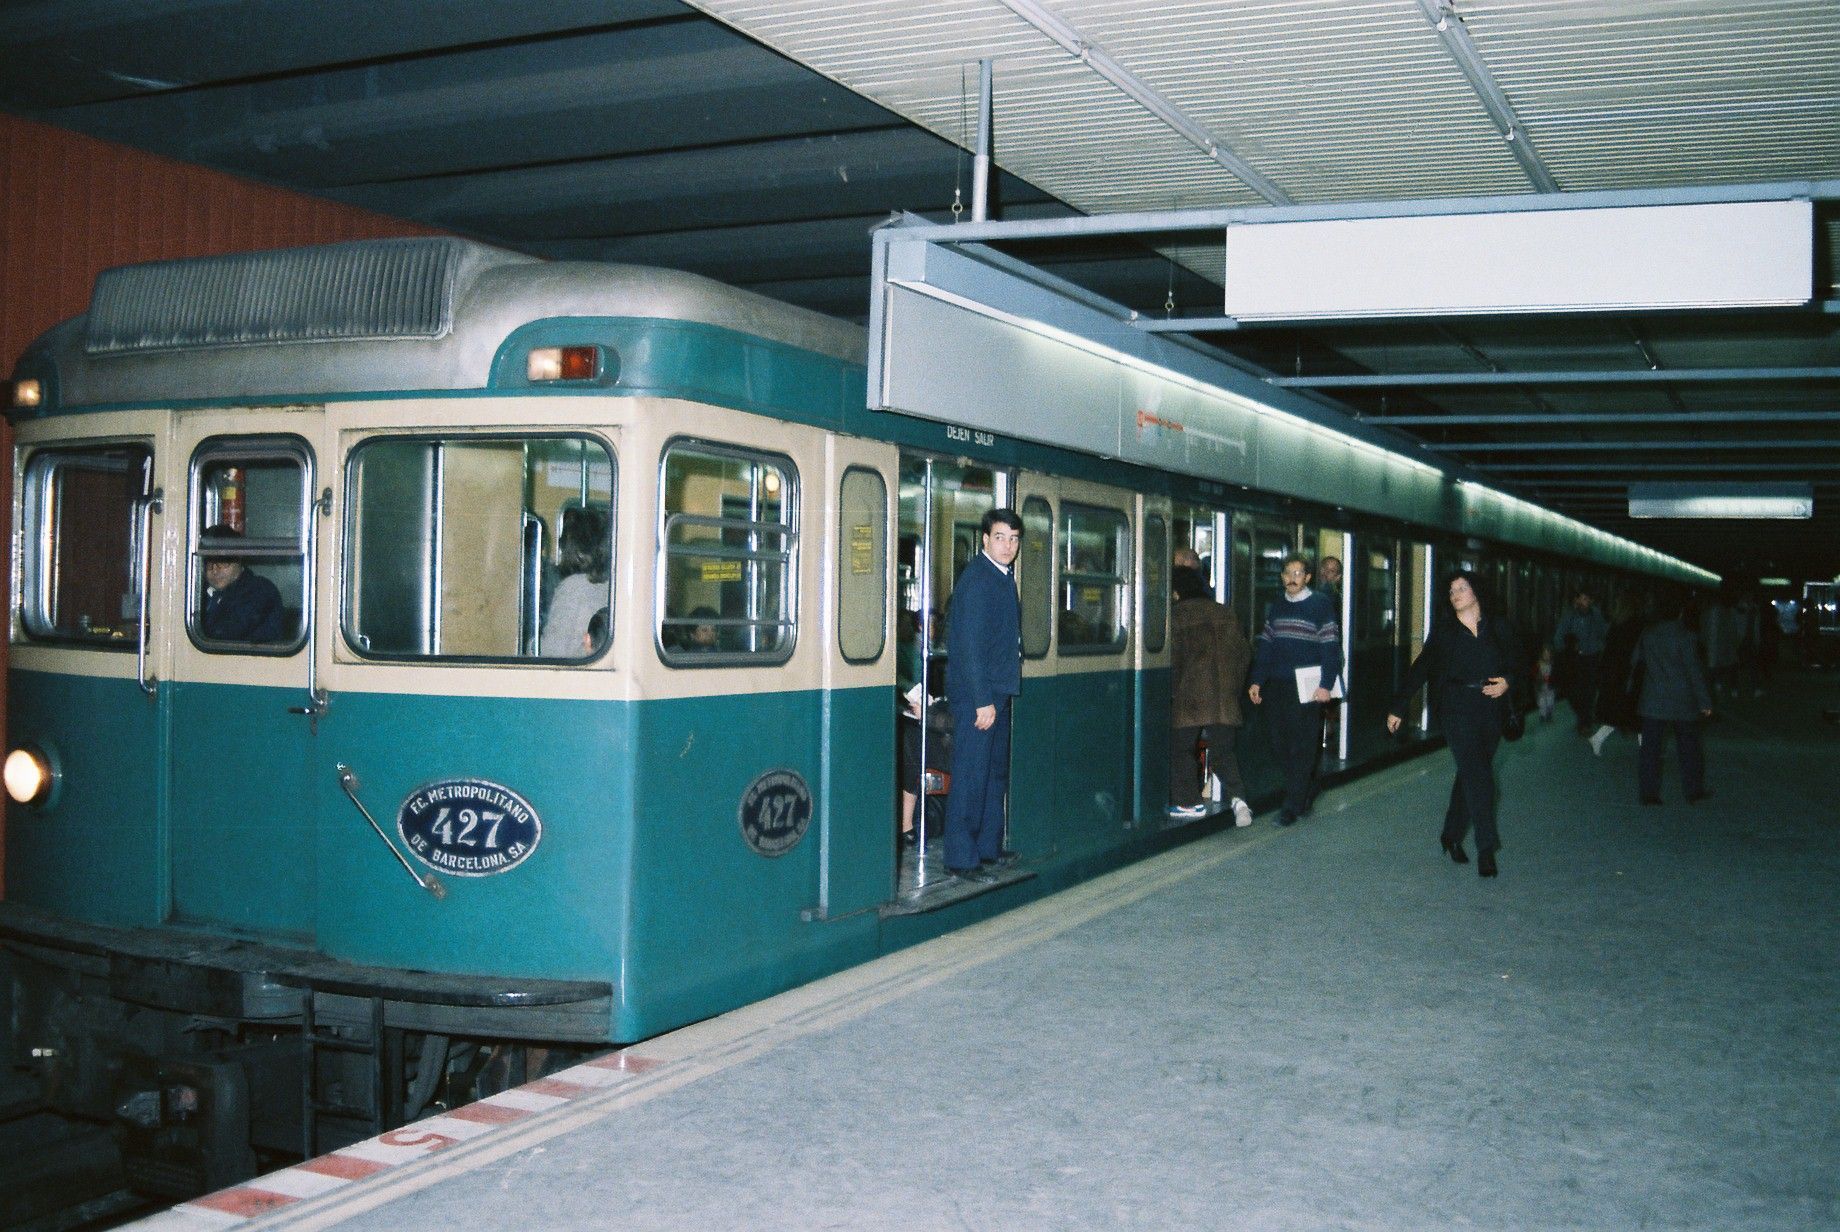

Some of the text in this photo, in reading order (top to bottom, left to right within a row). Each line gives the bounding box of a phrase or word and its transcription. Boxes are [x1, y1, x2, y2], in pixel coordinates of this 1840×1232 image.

[946, 425, 994, 446] DEJEN SALIR
[427, 785, 529, 824] METROPOLITANO
[431, 807, 505, 848] 427
[410, 833, 428, 852] DE
[378, 1128, 461, 1151] 5
